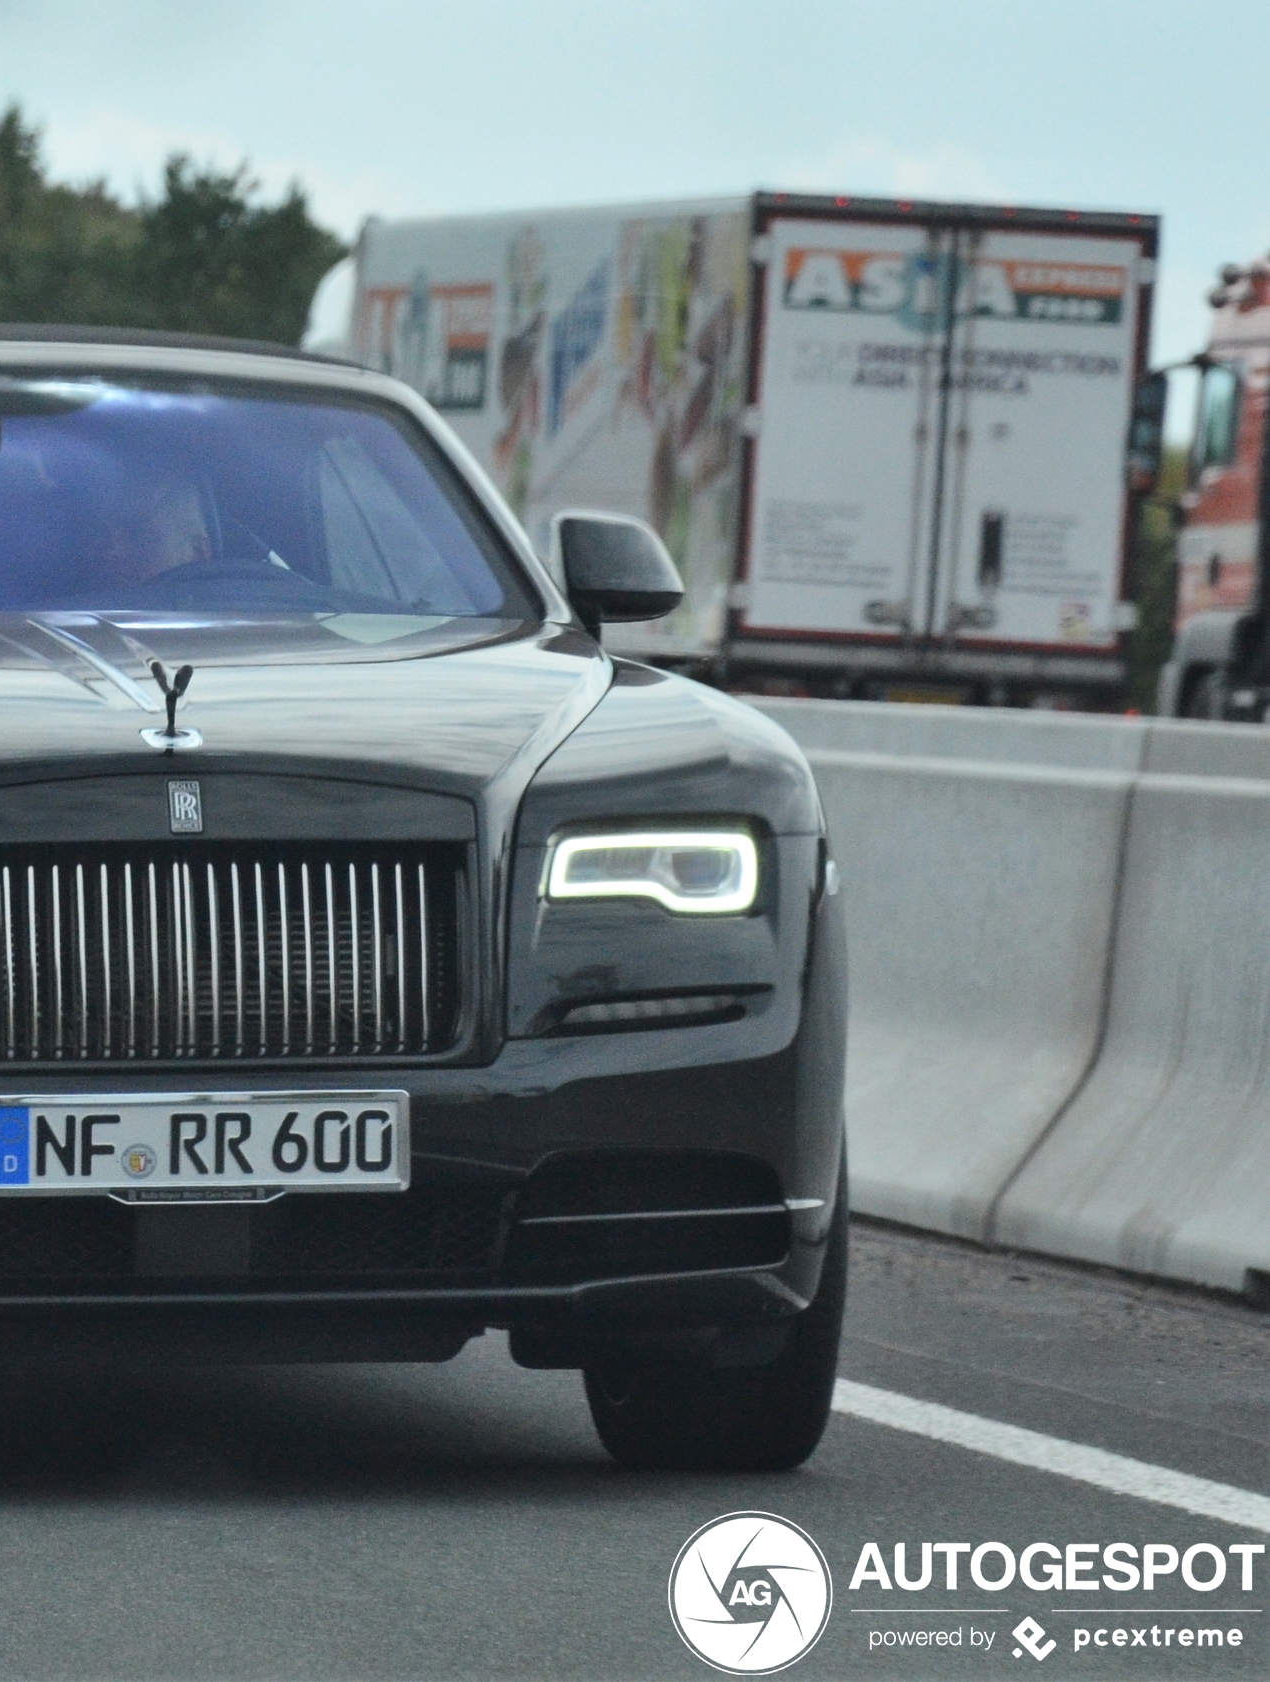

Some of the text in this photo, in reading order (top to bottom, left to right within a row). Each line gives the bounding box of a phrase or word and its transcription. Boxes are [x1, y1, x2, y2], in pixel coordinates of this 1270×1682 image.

[3, 1154, 19, 1174] D
[35, 1109, 393, 1177] NF RR 600
